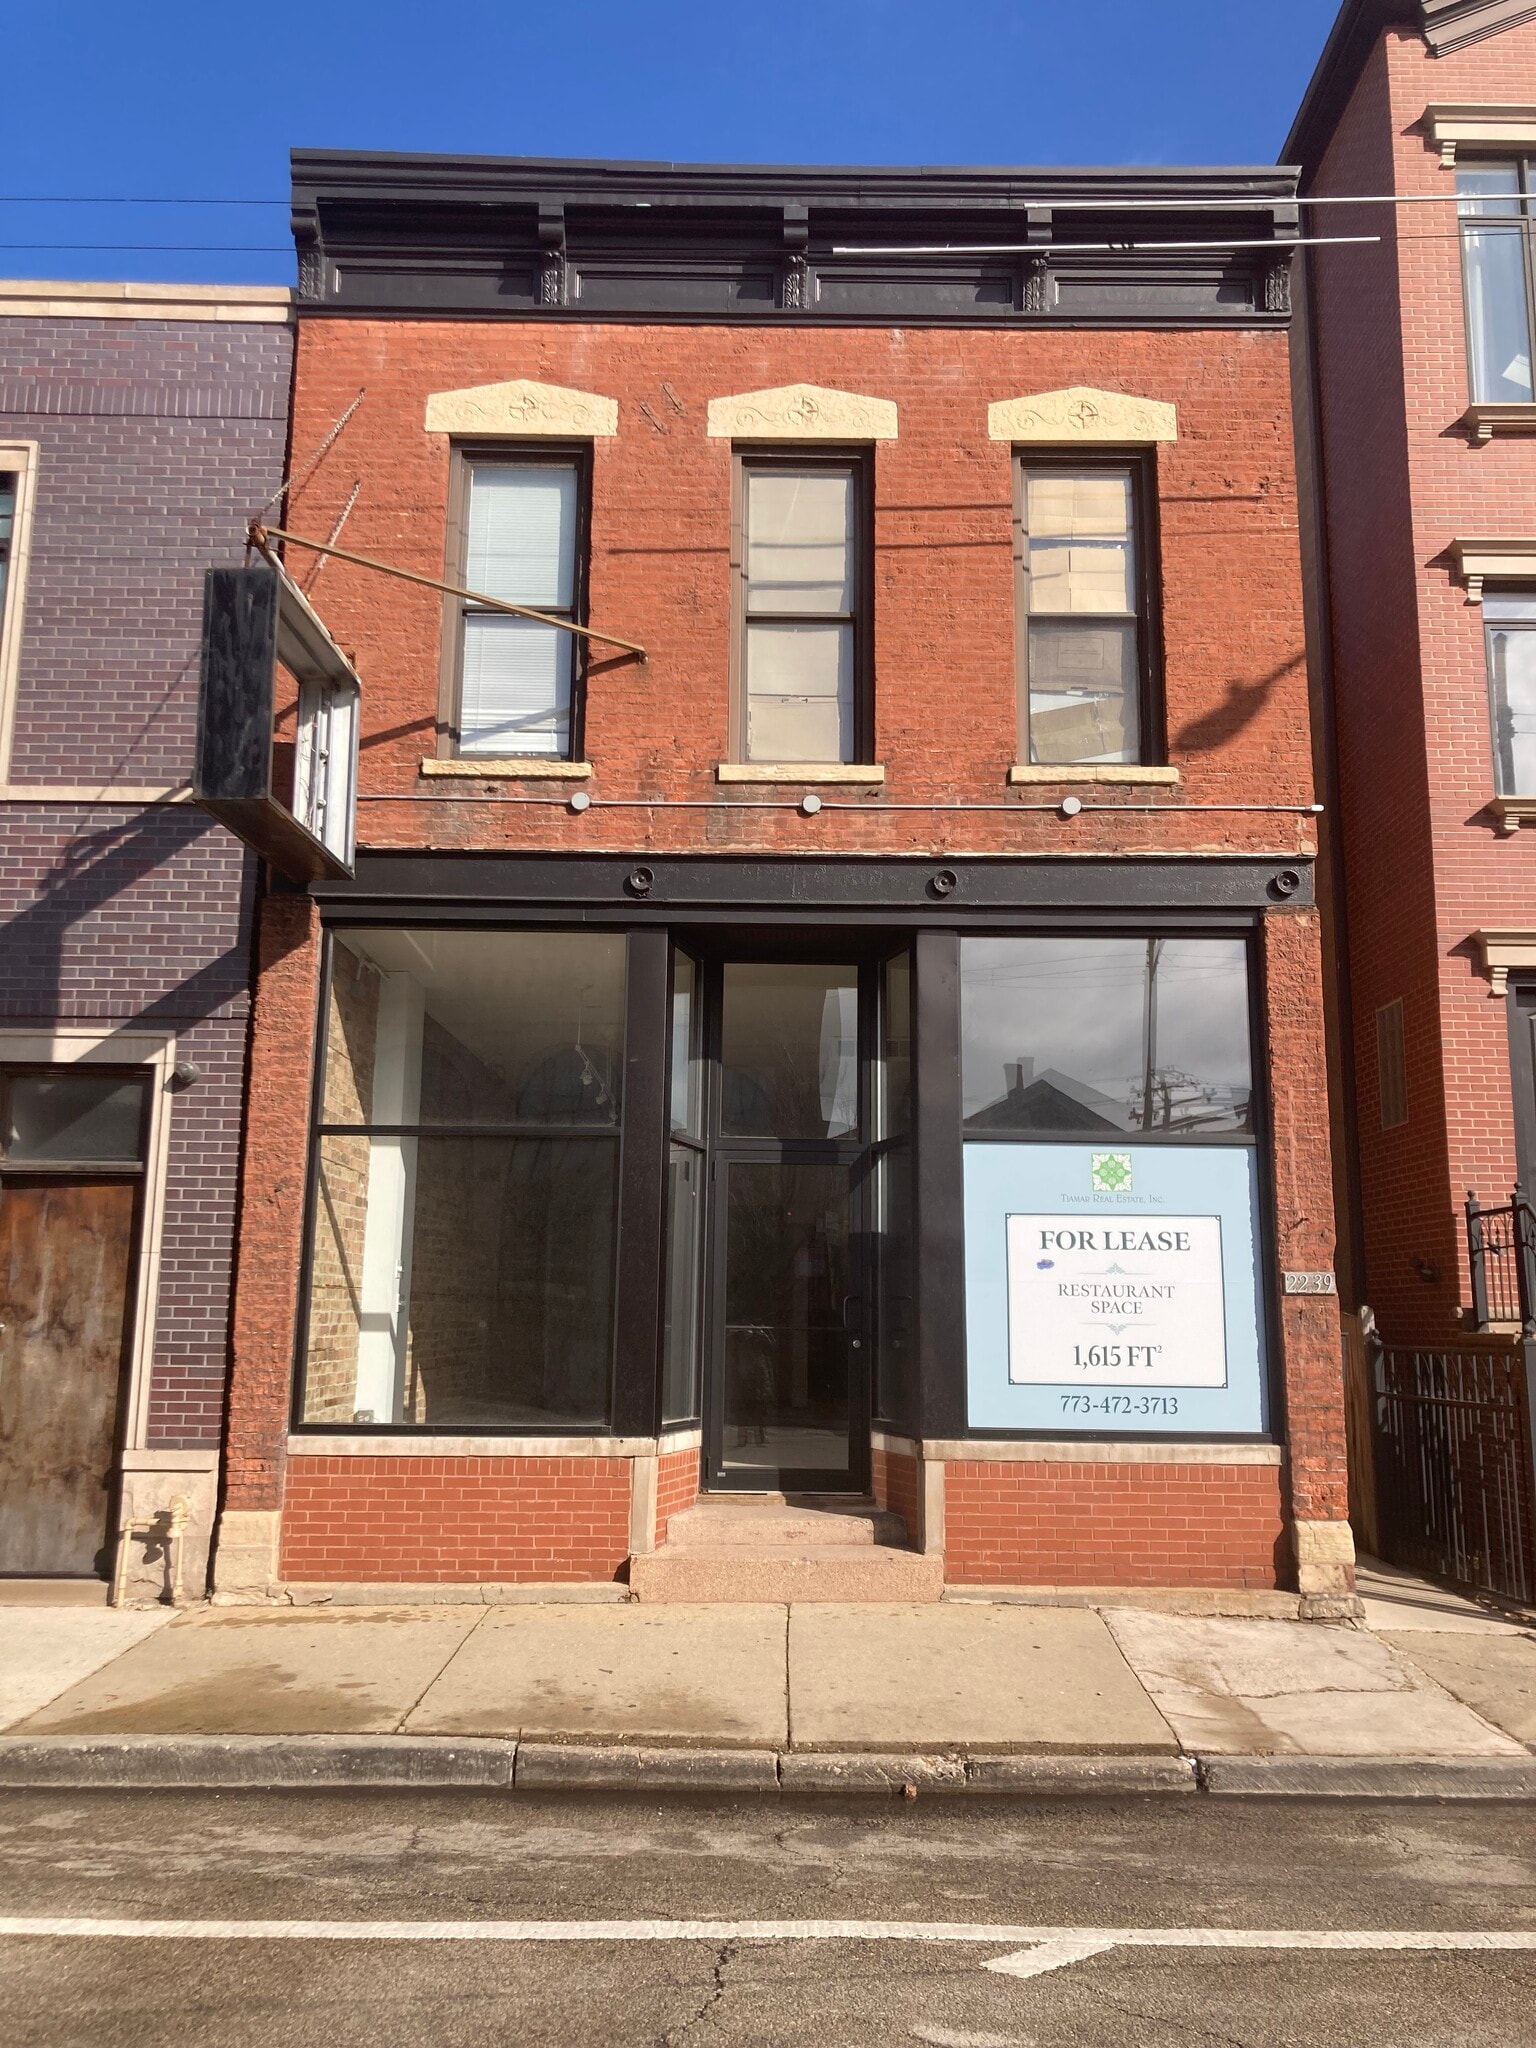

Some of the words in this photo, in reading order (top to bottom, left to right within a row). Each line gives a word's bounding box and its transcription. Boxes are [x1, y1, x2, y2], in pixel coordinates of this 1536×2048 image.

[1093, 1194, 1114, 1203] REAL
[1039, 1230, 1098, 1250] FOR
[1102, 1231, 1191, 1251] LEASE
[1058, 1284, 1175, 1298] RESTAURANT
[1286, 1274, 1333, 1293] 2239
[1091, 1301, 1143, 1314] SPACE
[1073, 1345, 1121, 1370] 1,615
[1060, 1395, 1178, 1415] 773-472-3713
